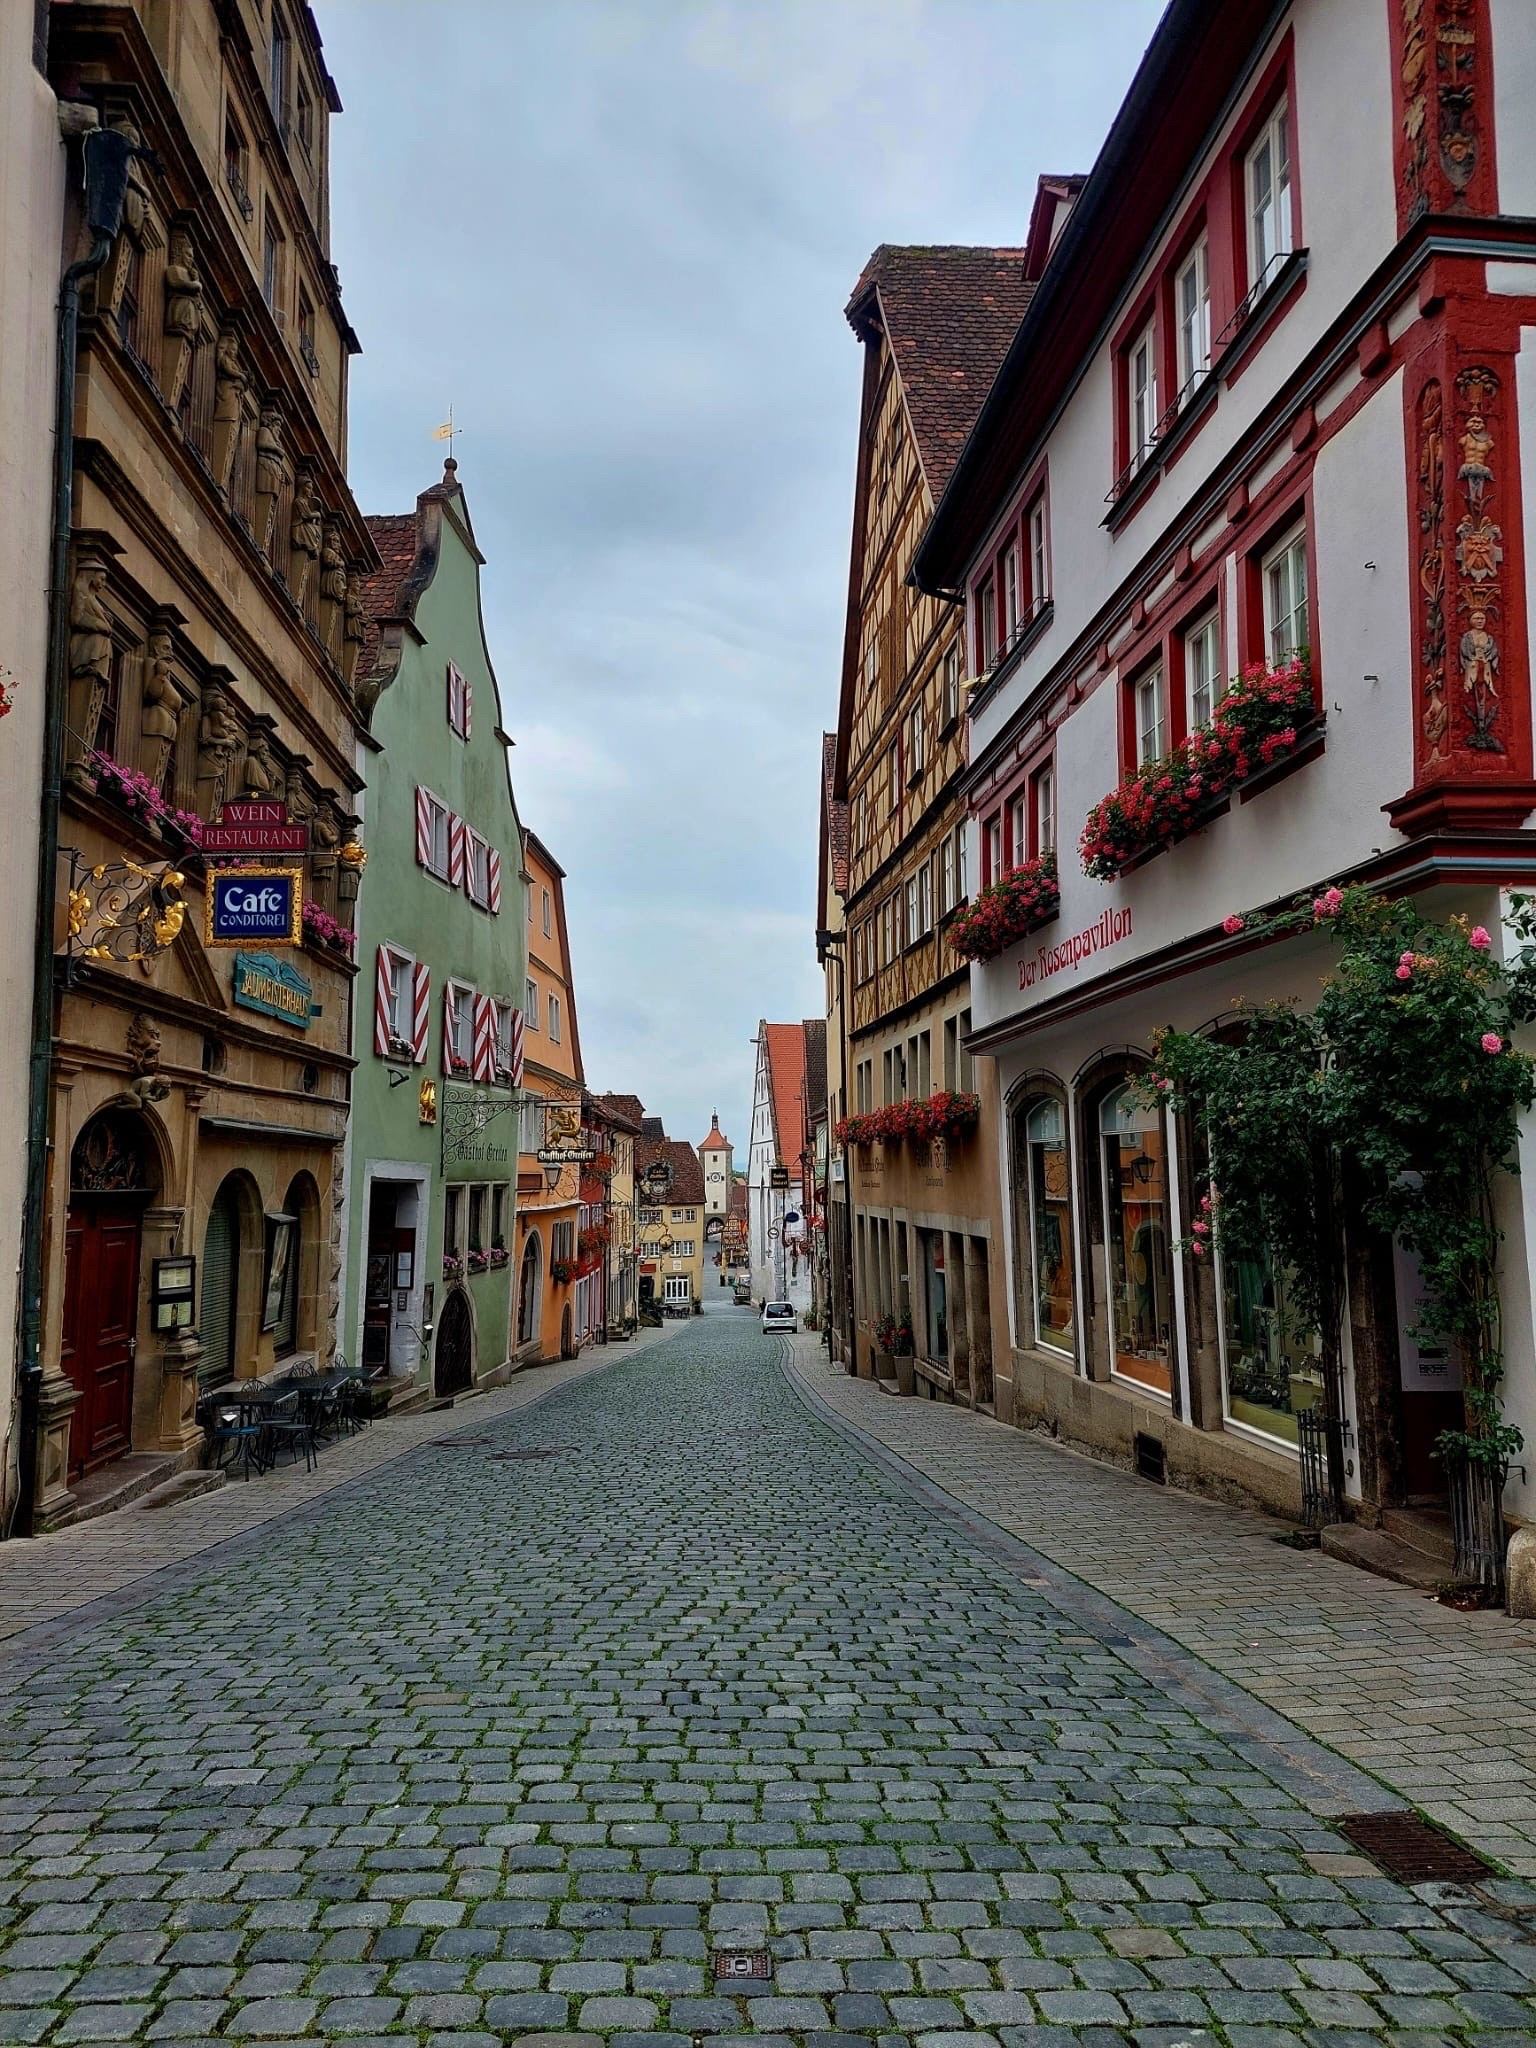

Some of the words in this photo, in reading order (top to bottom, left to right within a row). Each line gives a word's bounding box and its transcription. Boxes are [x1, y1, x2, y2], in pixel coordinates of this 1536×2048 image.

[229, 806, 280, 820] WEIN
[206, 830, 304, 845] RESTAURANT
[224, 887, 282, 912] Cafe
[220, 914, 285, 926] CONDITOREI
[1017, 960, 1037, 991] Der
[1038, 907, 1133, 981] Rosenpavillon
